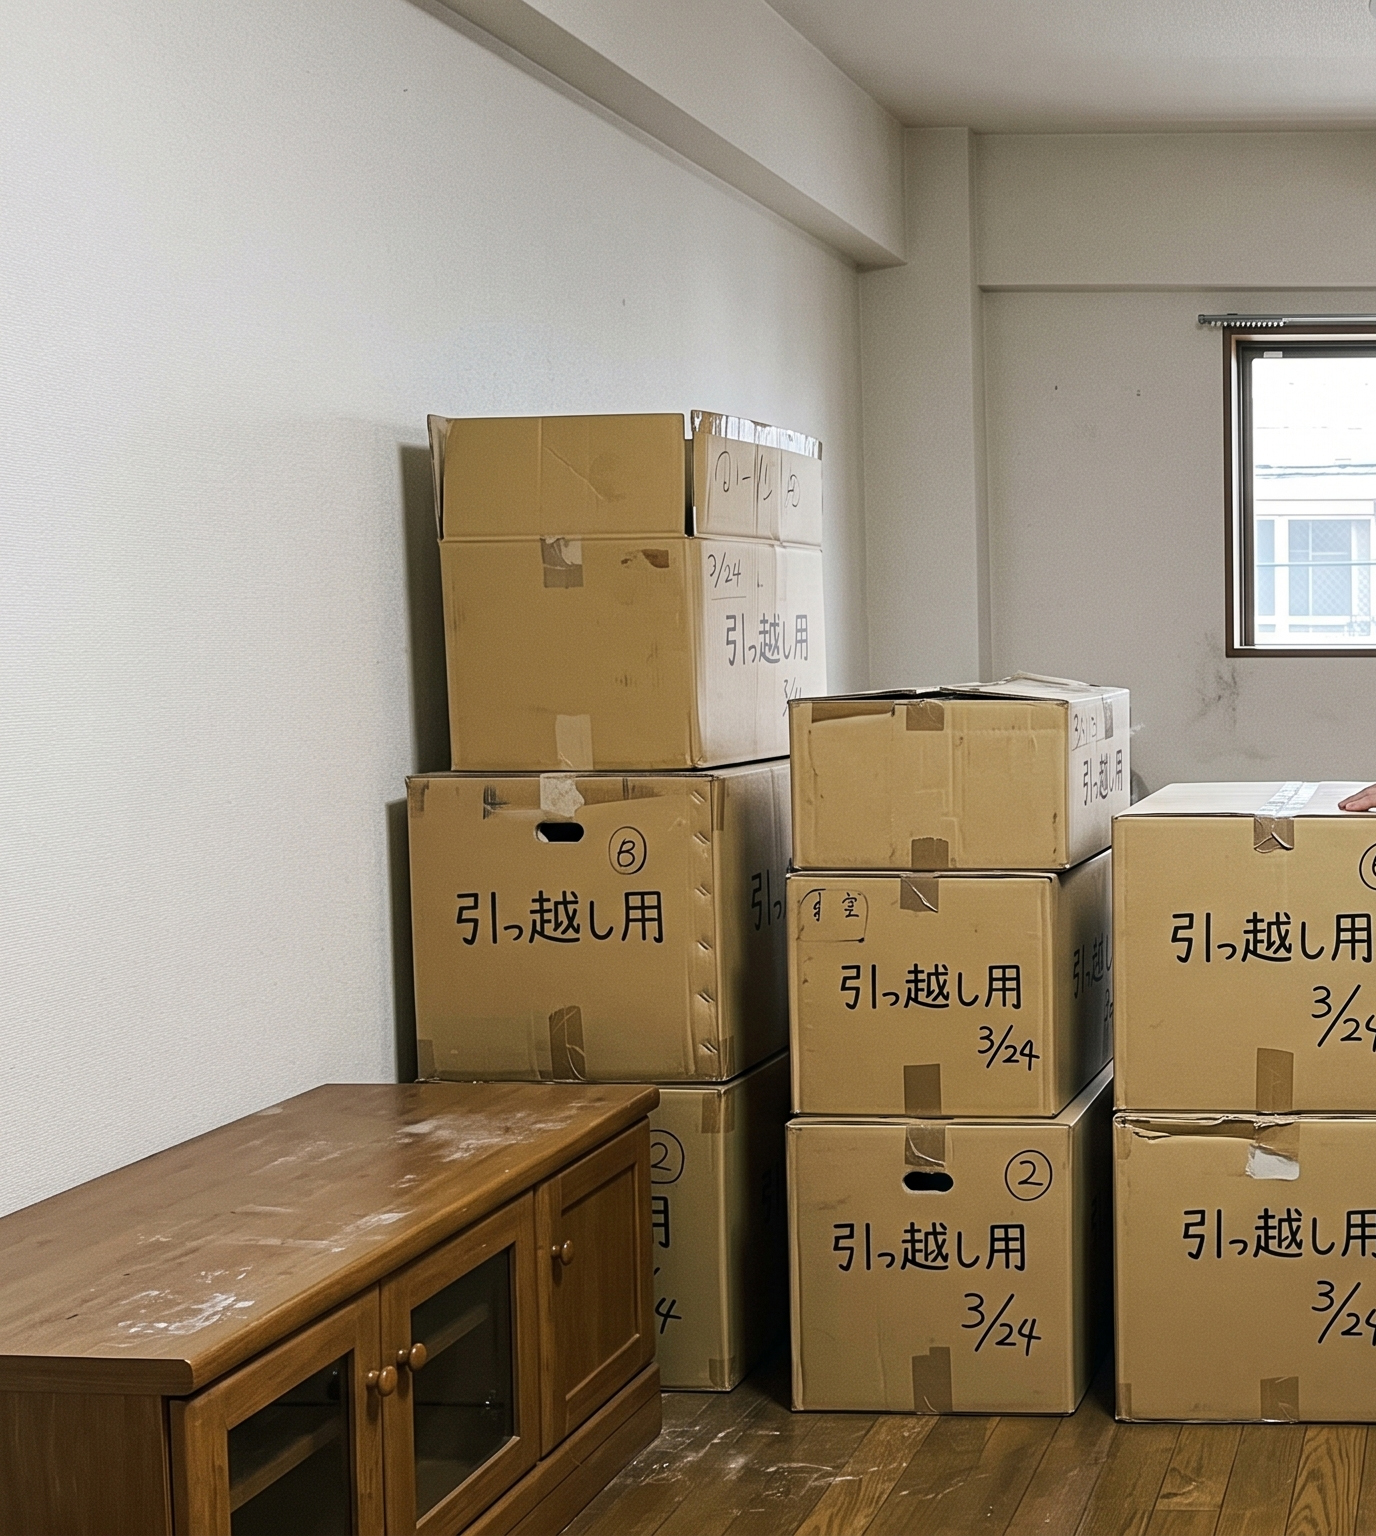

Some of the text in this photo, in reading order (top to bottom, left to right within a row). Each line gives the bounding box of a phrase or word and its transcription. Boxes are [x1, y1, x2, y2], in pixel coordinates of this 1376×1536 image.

[725, 613, 809, 667] 引っ越し用
[456, 890, 664, 946] 引っ越し用
[1170, 911, 1373, 964] 引っ越し用
[839, 963, 1022, 1010] 引っ越し用
[977, 1024, 1041, 1072] 3/24
[832, 1221, 1026, 1272] 引っ越し用
[960, 1292, 1042, 1357] 3/24
